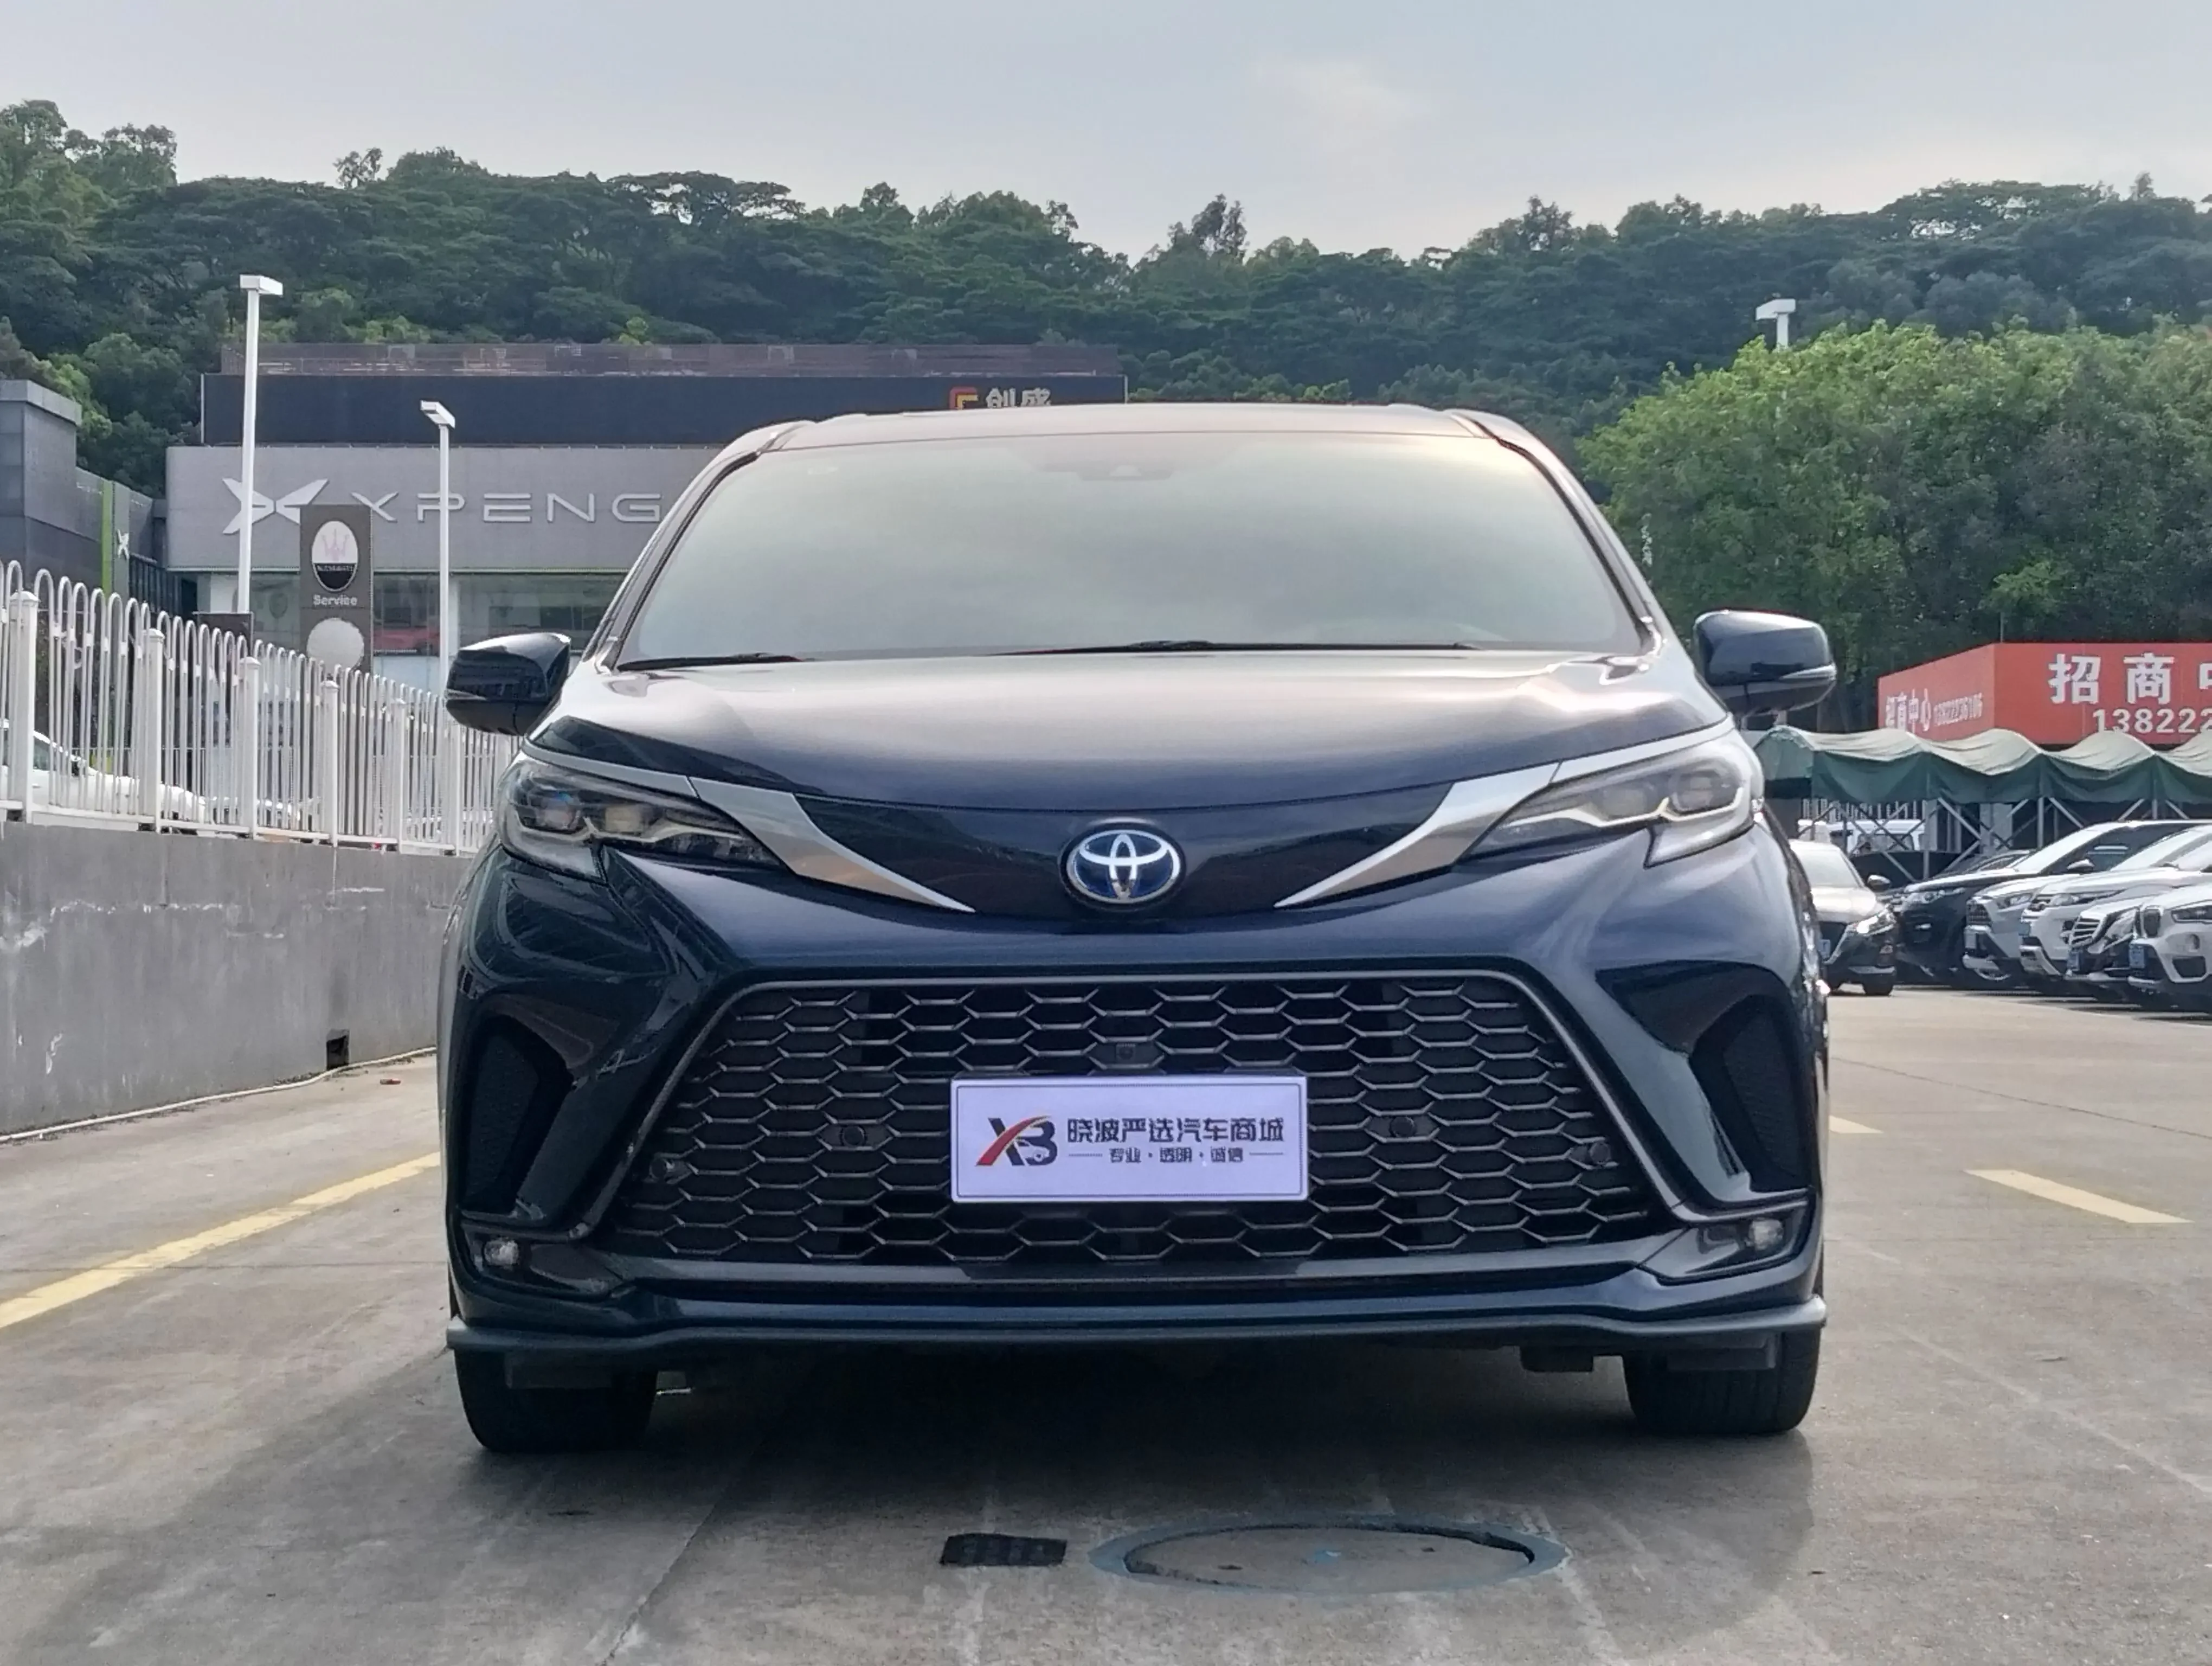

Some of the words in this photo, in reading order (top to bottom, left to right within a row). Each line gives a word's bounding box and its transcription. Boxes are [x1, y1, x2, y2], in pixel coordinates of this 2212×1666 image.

[351, 491, 661, 523] XPENG
[313, 594, 358, 606] Service
[2048, 652, 2212, 704] 招商
[1066, 1117, 1285, 1143] 晓波严选汽车商城
